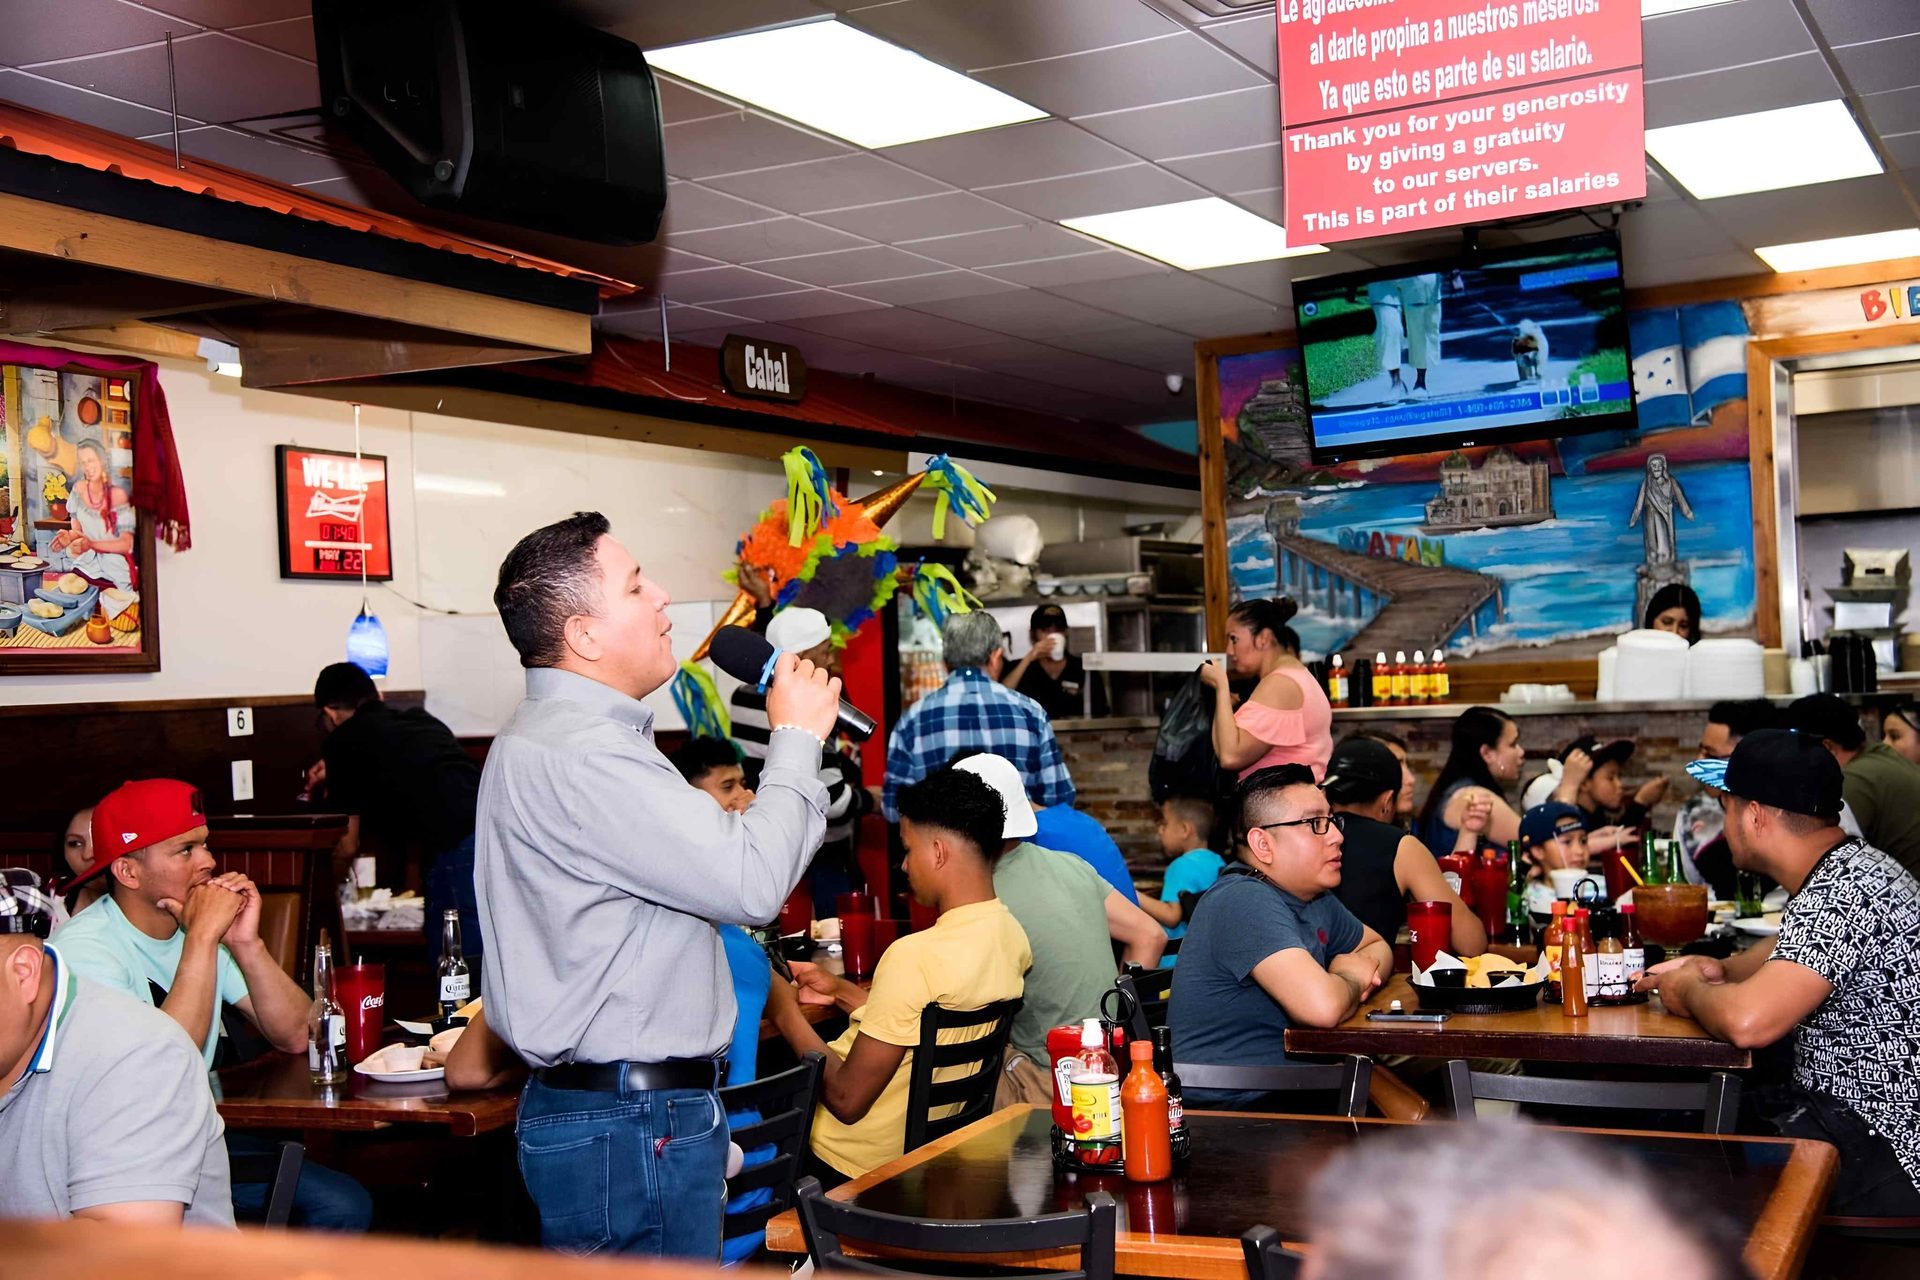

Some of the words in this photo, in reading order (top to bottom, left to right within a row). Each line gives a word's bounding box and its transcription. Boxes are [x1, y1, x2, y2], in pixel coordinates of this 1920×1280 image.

[1280, 0, 1299, 24] Le
[1309, 33, 1324, 65] al
[1327, 27, 1367, 62] darle
[1371, 17, 1429, 61] propina
[1433, 18, 1443, 43] a
[1447, 3, 1518, 40] nuestros
[1319, 80, 1338, 110] Ya
[1342, 80, 1370, 114] que
[1374, 67, 1408, 101] esto
[1412, 69, 1431, 95] es
[1435, 55, 1477, 98] parte
[1482, 50, 1502, 82] de
[1506, 52, 1526, 78] su
[1530, 34, 1593, 73] salario.
[1289, 126, 1356, 153] Thank
[1362, 121, 1401, 146] you
[1407, 114, 1439, 134] for
[1445, 106, 1496, 132] your
[1502, 81, 1629, 122] generosity
[1346, 152, 1373, 174] by
[1379, 142, 1445, 171] giving
[1452, 139, 1466, 154] a
[1473, 121, 1566, 155] gratuity
[1372, 176, 1396, 194] to
[1402, 171, 1439, 190] our
[1445, 156, 1540, 184] servers.
[1302, 210, 1350, 232] This
[1355, 206, 1375, 224] is
[1381, 197, 1427, 226] part
[1433, 192, 1457, 213] of
[1463, 184, 1518, 209] their
[1524, 172, 1620, 200] salaries
[744, 344, 790, 394] Cabal
[237, 710, 245, 730] 6
[1818, 909, 1851, 930] MARC
[1846, 911, 1875, 933] ECKO
[1849, 903, 1881, 926] MARC
[1813, 917, 1846, 939] ECKO
[1800, 945, 1833, 967] MARC
[1828, 946, 1857, 969] ECKO
[1832, 936, 1862, 962] MARC
[1797, 954, 1829, 976] ECKO
[1894, 984, 1920, 1001] ECK
[1813, 1049, 1838, 1064] MARC
[1814, 1061, 1838, 1073] ECKO
[1833, 1075, 1860, 1089] MARC
[1858, 1068, 1890, 1082] ECKO
[1831, 1086, 1862, 1099] ECKO
